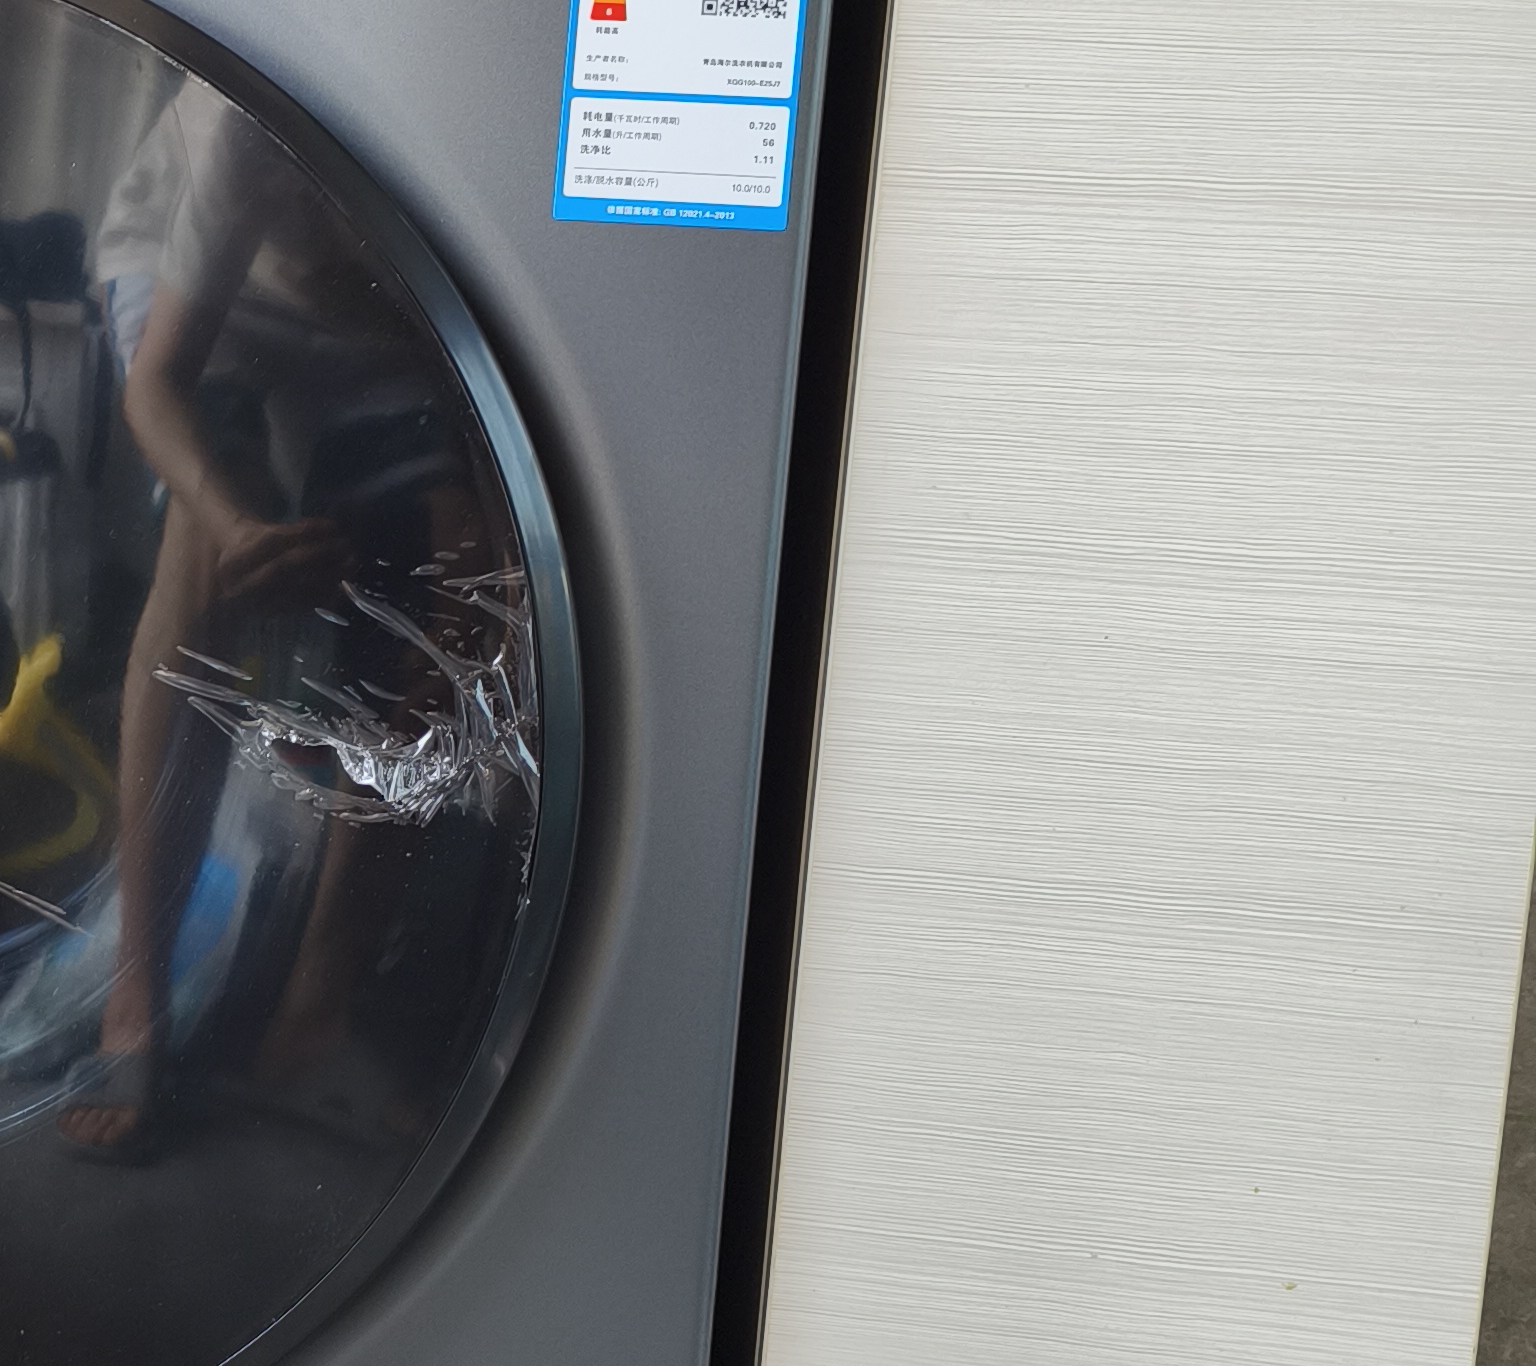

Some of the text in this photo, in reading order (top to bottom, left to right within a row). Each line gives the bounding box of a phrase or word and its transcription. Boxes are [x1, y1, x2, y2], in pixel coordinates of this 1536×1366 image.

[748, 121, 777, 131] 0.720
[762, 138, 775, 147] 56
[580, 144, 612, 155] 洗净比
[753, 155, 774, 165] 1.11
[731, 183, 771, 194] 10.0/10.0
